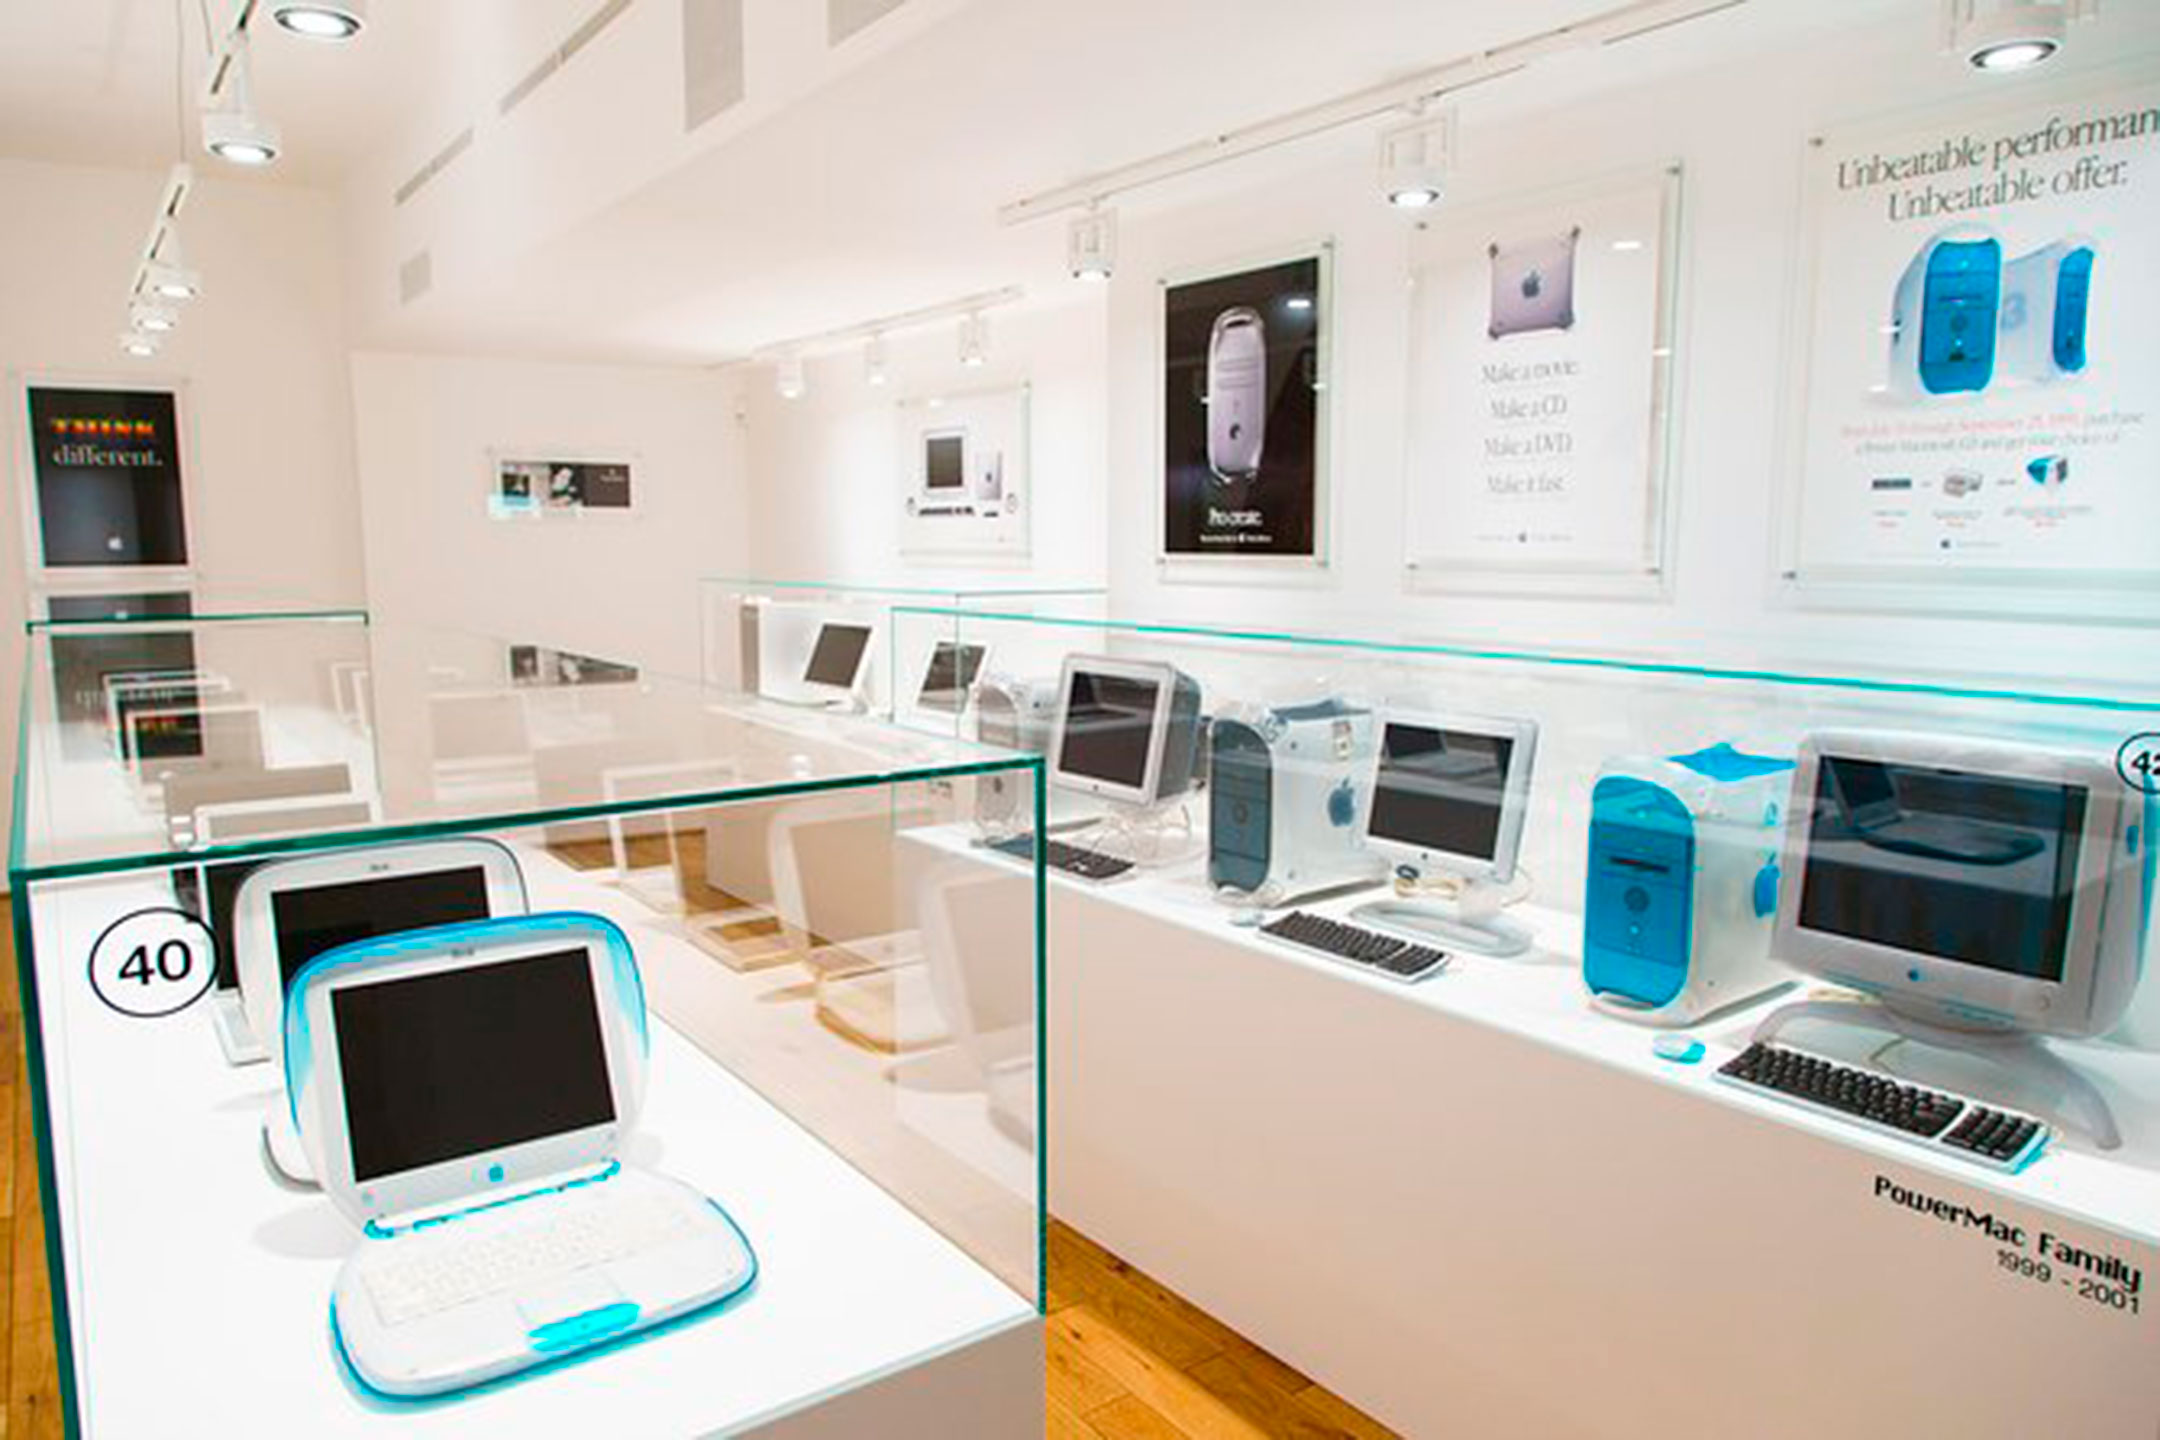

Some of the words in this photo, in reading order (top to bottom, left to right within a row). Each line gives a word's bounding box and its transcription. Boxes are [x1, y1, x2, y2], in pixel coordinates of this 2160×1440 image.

[1838, 136, 1987, 188] Unbeatable
[1889, 168, 2045, 221] Unbeatable
[1482, 361, 1520, 383] Make
[1491, 397, 1528, 418] Make
[53, 442, 163, 467] different.
[1484, 433, 1522, 456] Make
[1487, 473, 1525, 494] Make
[118, 938, 193, 986] 40
[1874, 1175, 2027, 1247] PowerMac
[2038, 1231, 2142, 1294] Family
[1997, 1249, 2052, 1284] 1999
[2078, 1277, 2140, 1315] 2001
